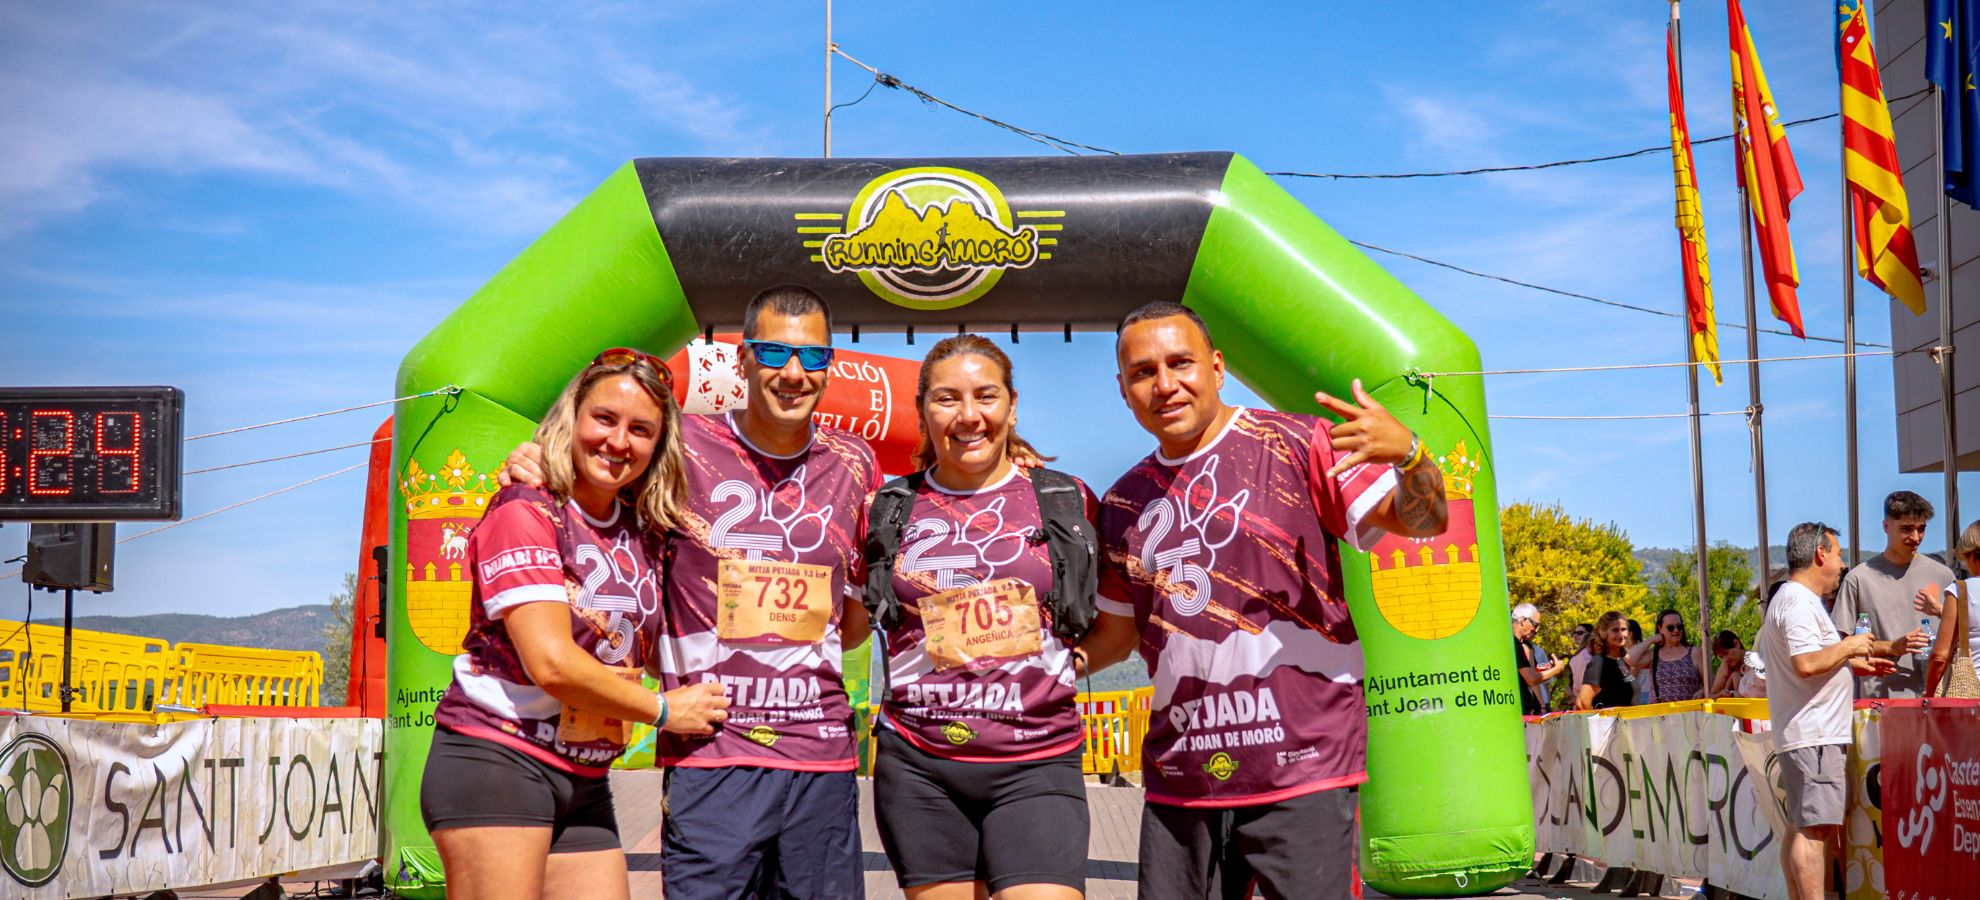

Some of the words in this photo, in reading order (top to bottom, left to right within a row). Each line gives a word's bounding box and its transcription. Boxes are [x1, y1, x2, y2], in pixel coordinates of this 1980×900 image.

[772, 566, 801, 576] PETJADA
[755, 576, 809, 610] 732
[769, 611, 797, 623] DENIS
[955, 594, 1013, 634] 705
[965, 628, 1014, 647] ANGEÑICA
[1368, 665, 1480, 695] Ajuntament
[1482, 665, 1501, 681] de
[1169, 687, 1281, 733] PETJADA
[1395, 697, 1444, 713] Joan
[1455, 691, 1478, 708] de
[1483, 689, 1515, 706] Moró
[1190, 733, 1223, 752] JOAN
[1224, 730, 1240, 748] DE
[1242, 722, 1285, 746] MORÓ
[99, 755, 245, 860] SANT
[258, 748, 387, 845] JOAN
[1953, 790, 1980, 821] Essen
